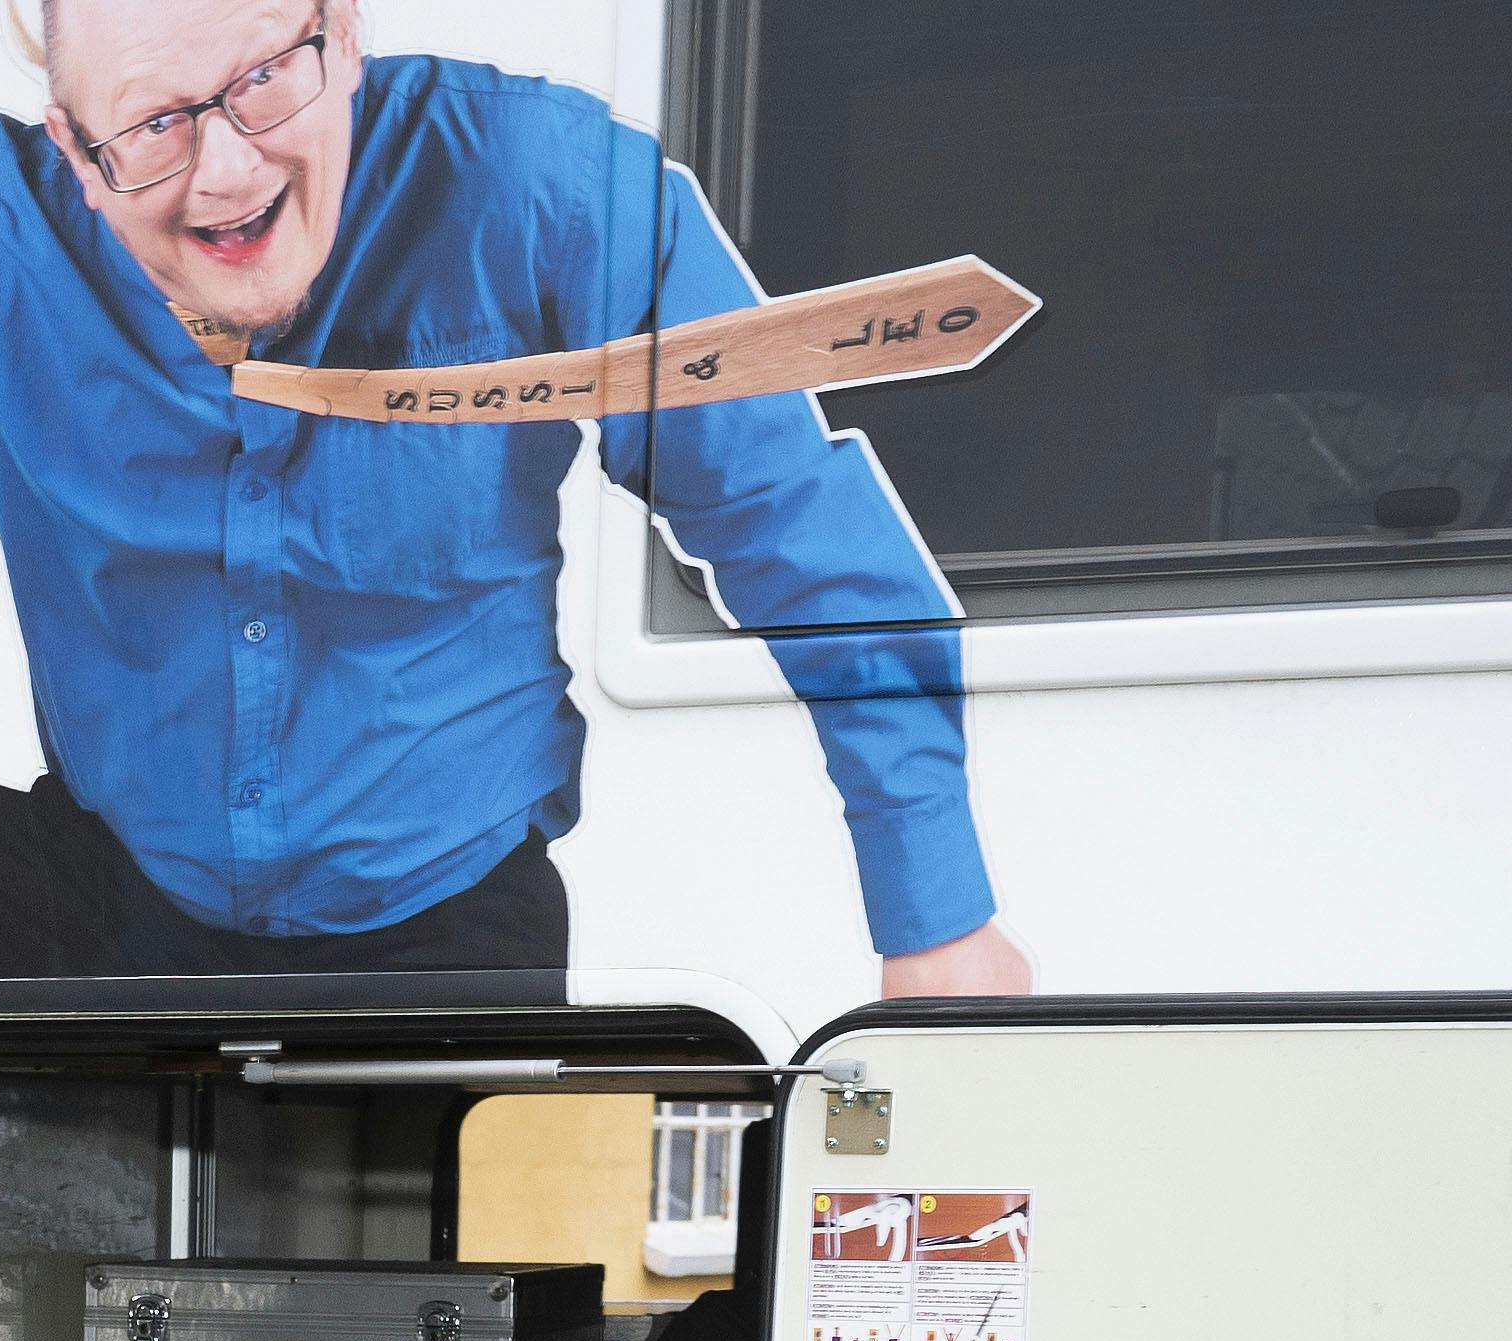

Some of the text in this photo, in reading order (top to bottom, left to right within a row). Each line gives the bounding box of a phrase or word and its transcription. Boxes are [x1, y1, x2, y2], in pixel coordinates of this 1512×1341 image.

[383, 305, 979, 415] SUSSI & LEO
